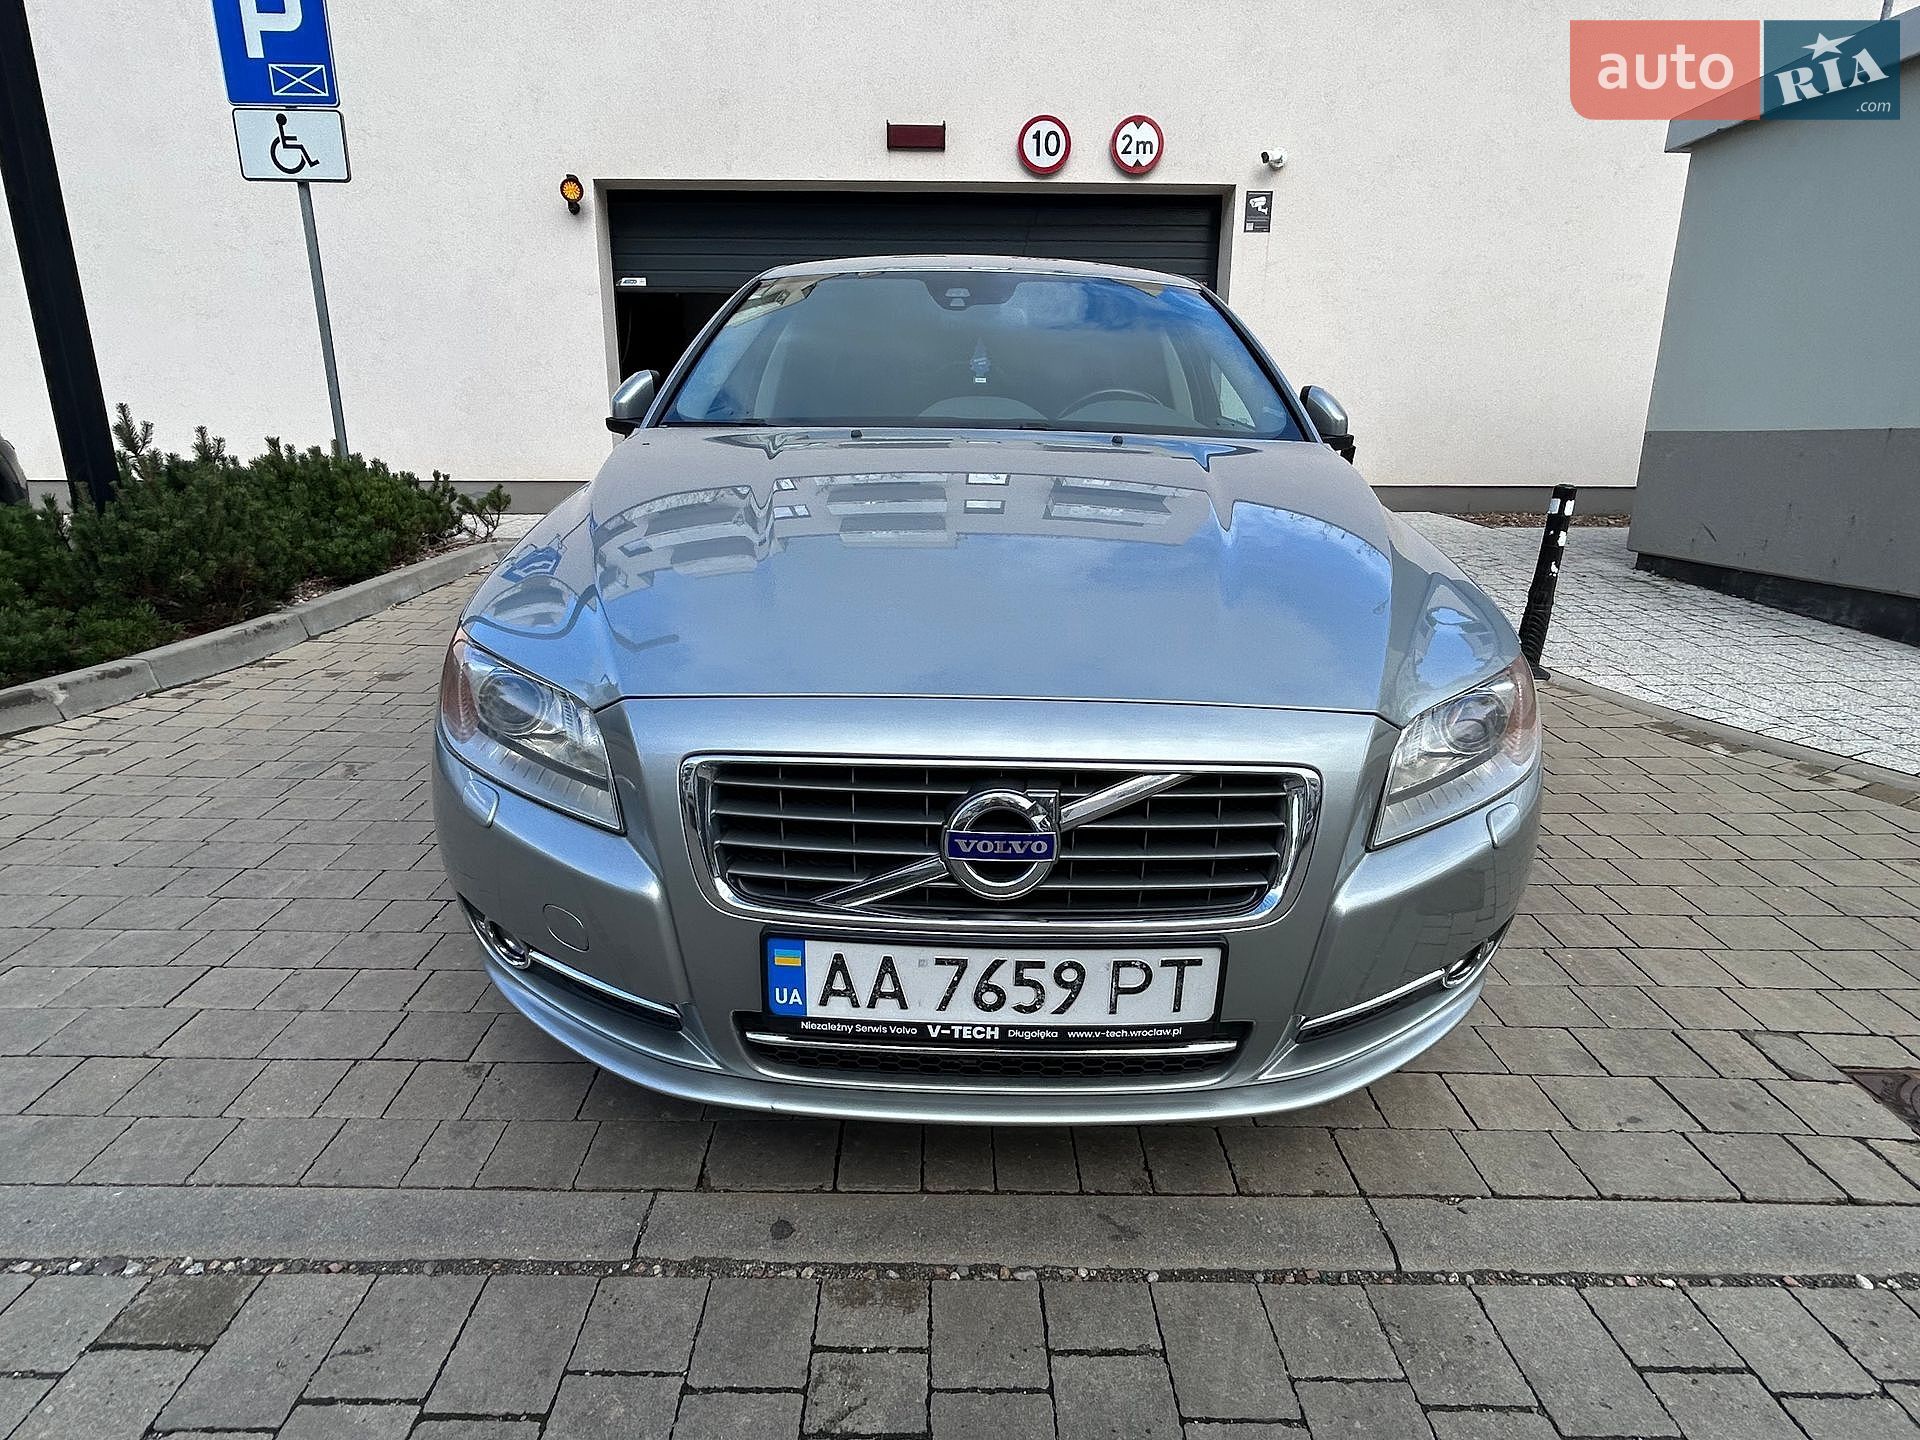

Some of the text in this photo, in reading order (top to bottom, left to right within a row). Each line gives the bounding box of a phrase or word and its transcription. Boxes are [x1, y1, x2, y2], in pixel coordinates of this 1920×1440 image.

[239, 0, 303, 59] P
[1032, 130, 1061, 157] 10
[954, 839, 1048, 854] VOLVO
[817, 952, 1203, 1016] AA 7659 PT
[775, 987, 803, 1006] UA
[801, 1021, 854, 1034] Niezależny
[855, 1024, 888, 1034] Serwis
[889, 1025, 918, 1035] Volvo
[926, 1024, 1000, 1040] V-TECH
[1067, 1026, 1183, 1039] www.v-tech.wroclaw.pl
